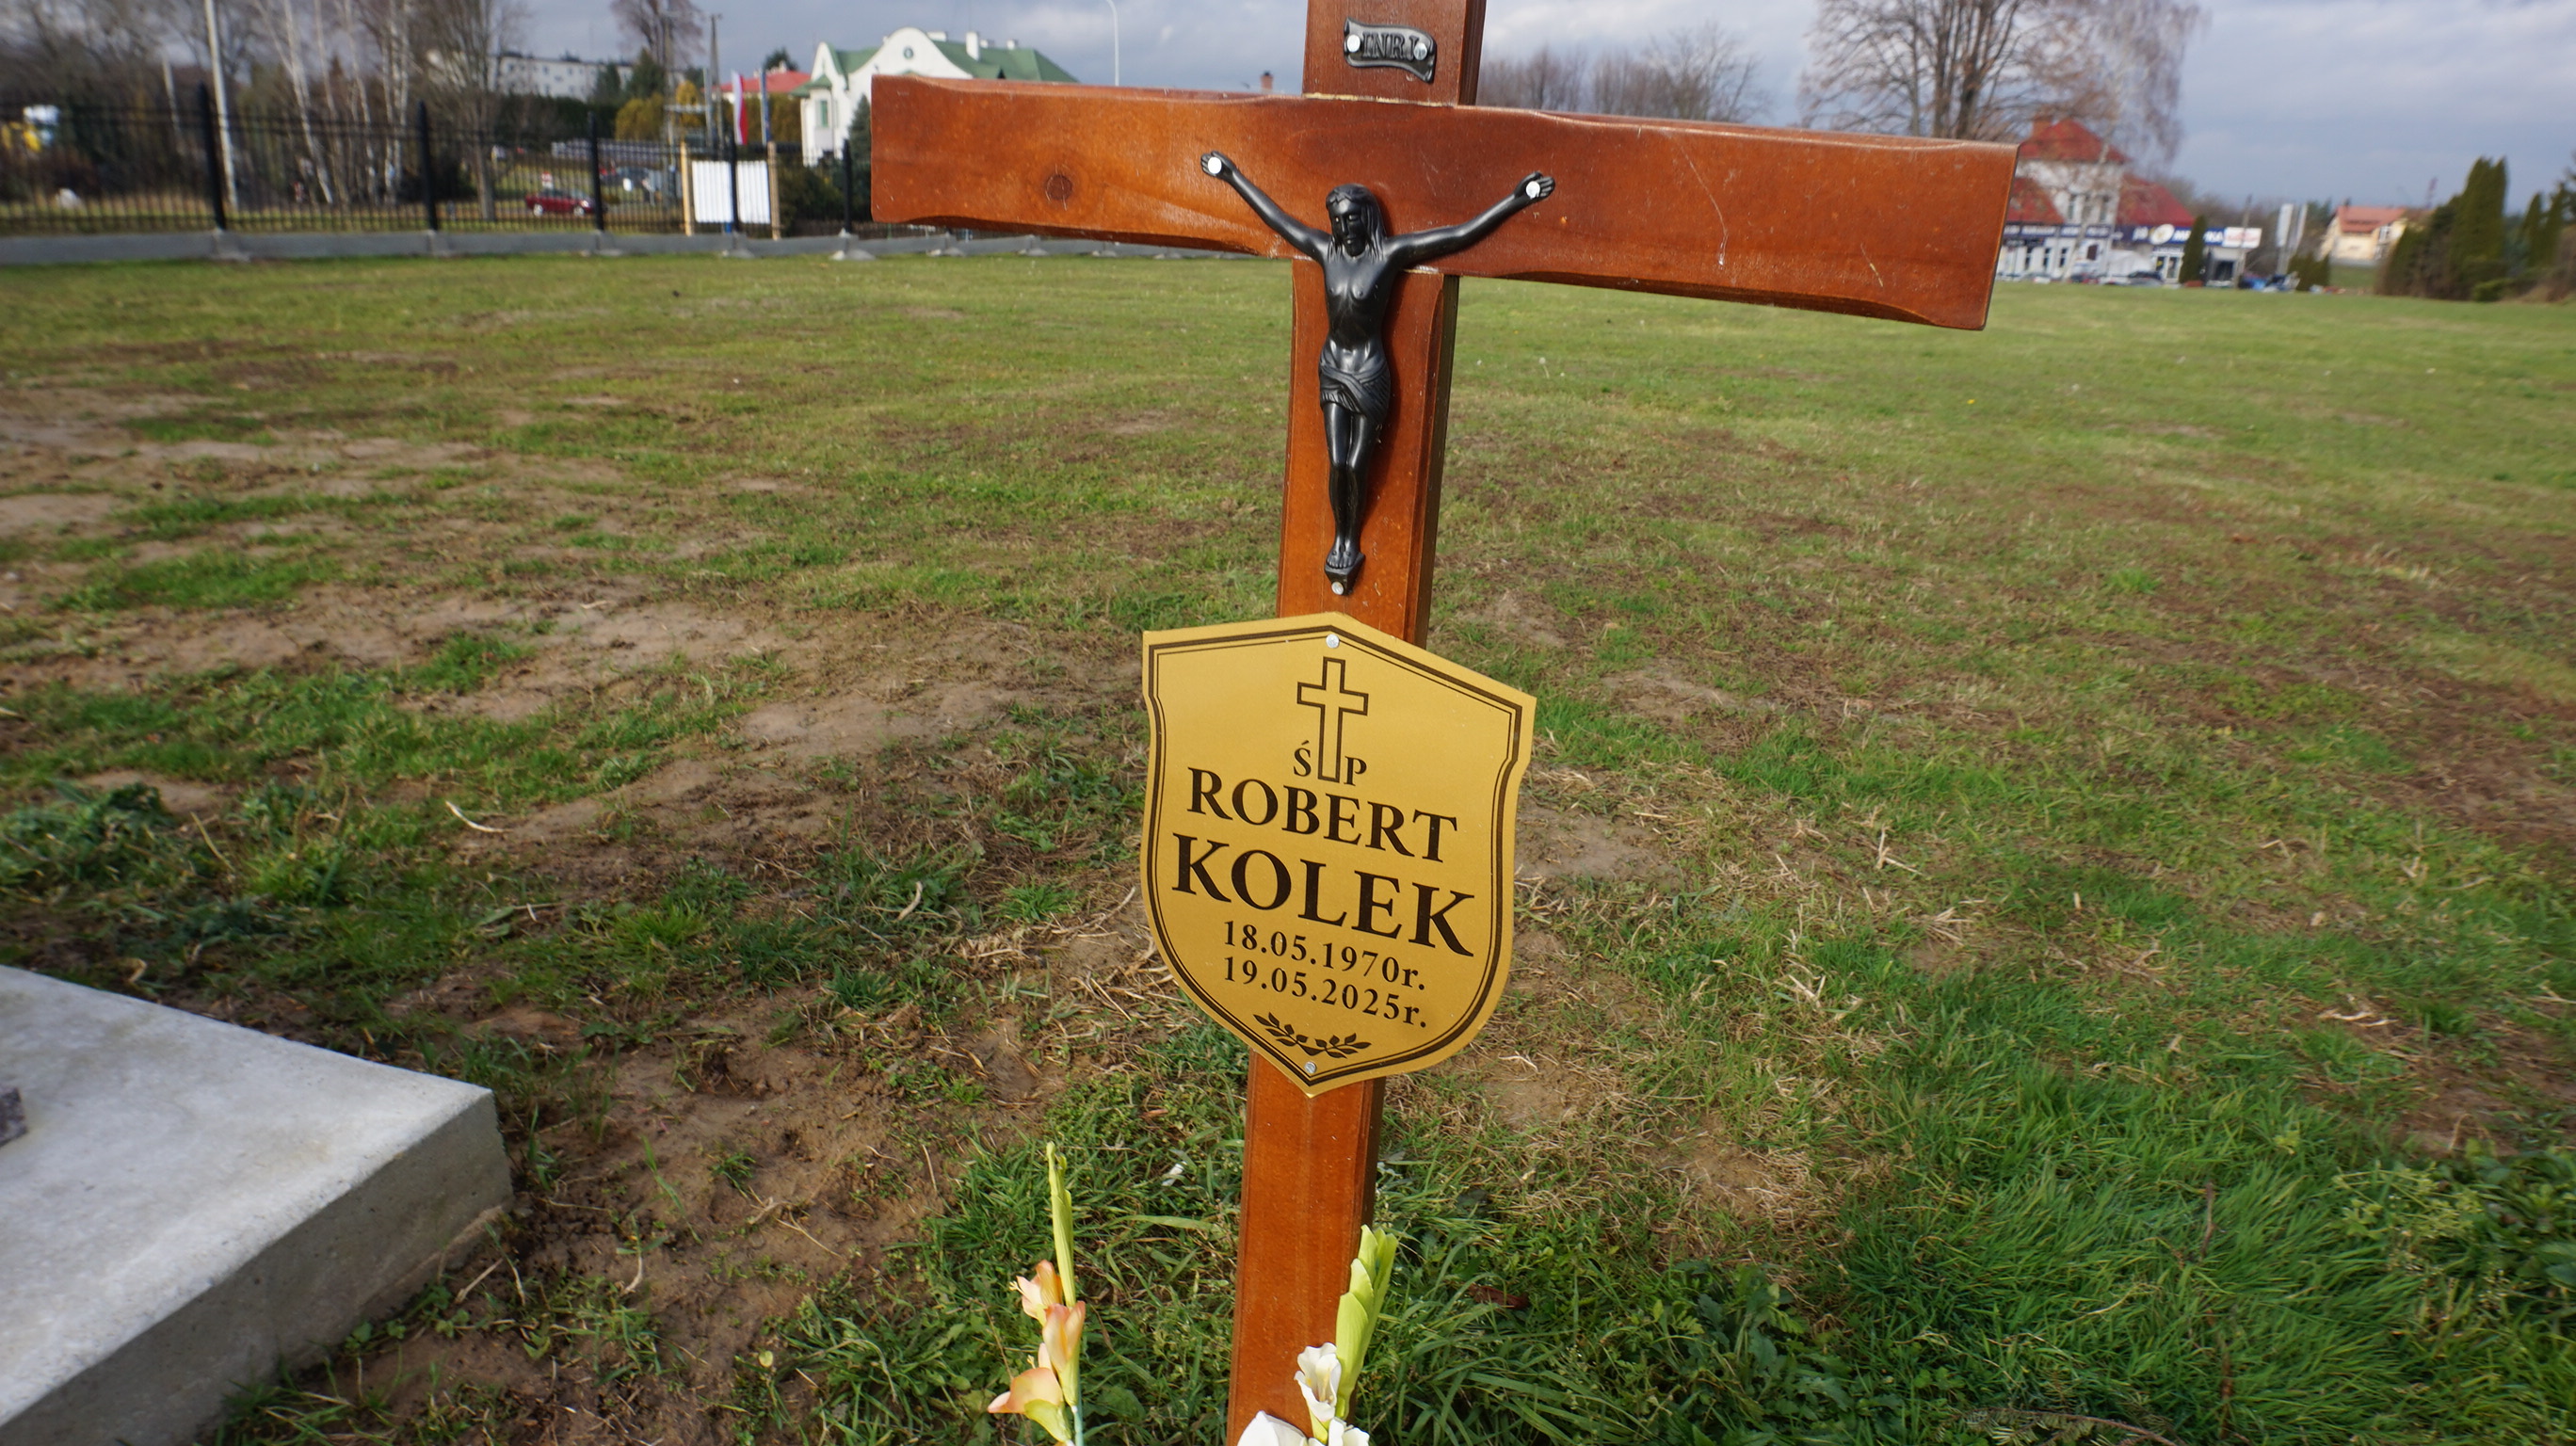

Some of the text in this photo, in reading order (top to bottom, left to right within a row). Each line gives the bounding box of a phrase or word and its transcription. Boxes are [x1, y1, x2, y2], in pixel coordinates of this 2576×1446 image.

[1293, 740, 1368, 787] Ś P
[1186, 766, 1458, 863] ROBERT
[1171, 832, 1475, 957] KOLEK
[1224, 920, 1426, 991] 18.05.1970r.
[1224, 956, 1427, 1029] 19.05.2025r.
